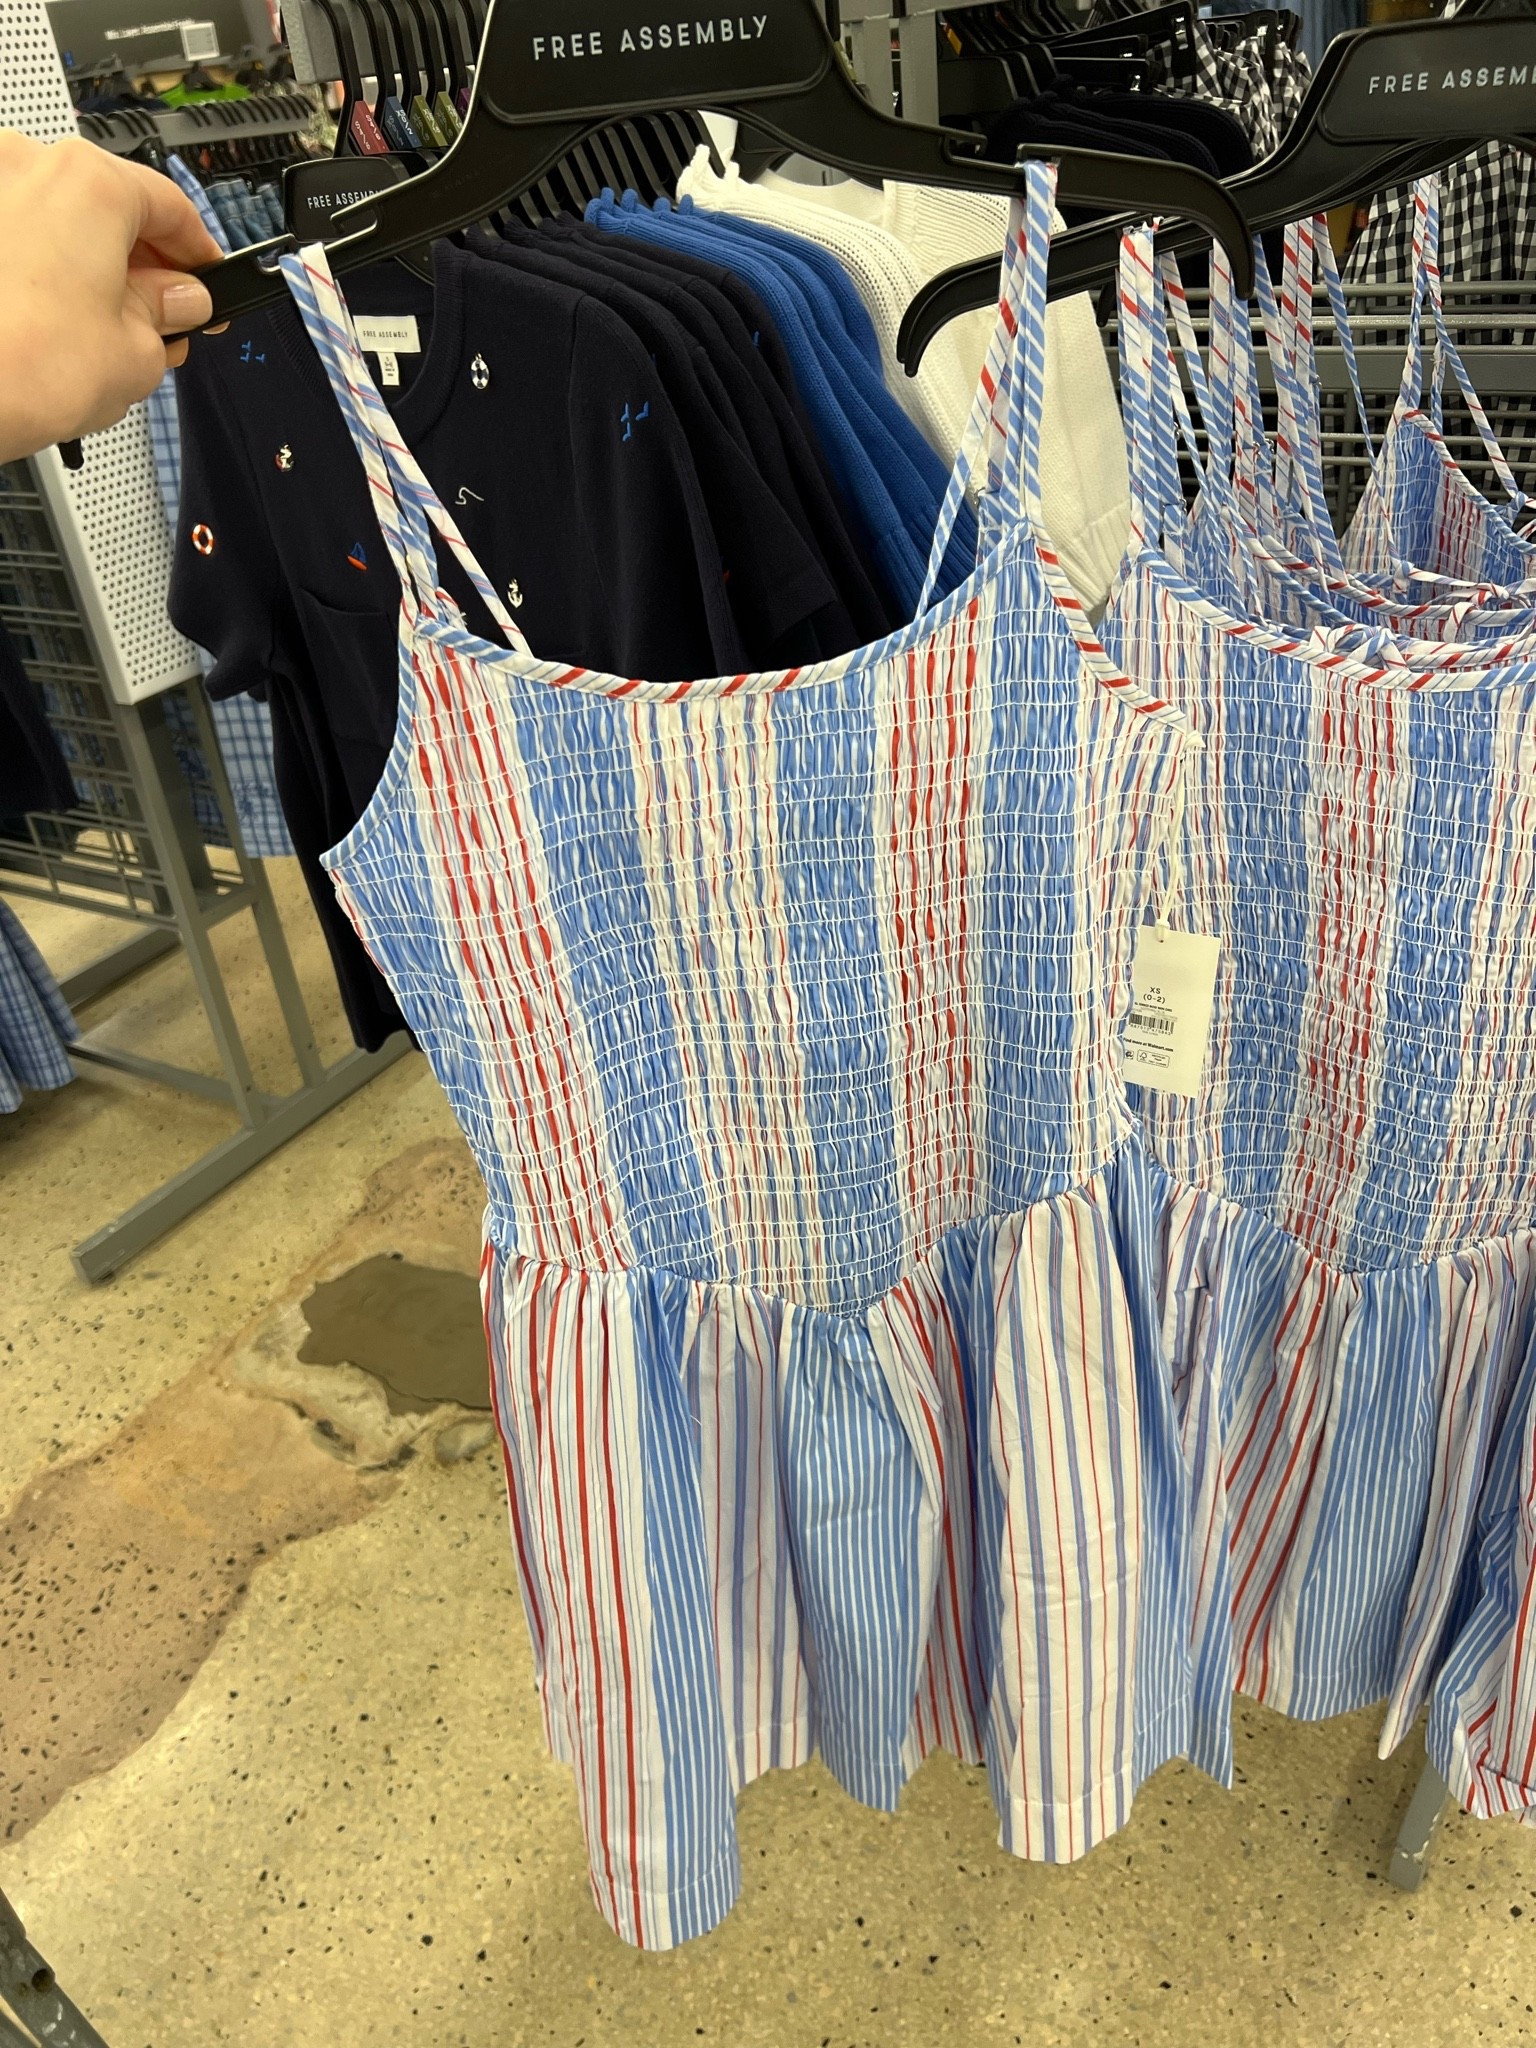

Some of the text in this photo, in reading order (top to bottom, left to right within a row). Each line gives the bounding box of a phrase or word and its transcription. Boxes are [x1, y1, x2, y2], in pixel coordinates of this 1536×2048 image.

[532, 14, 768, 61] FREE ASSEMBLY
[1368, 71, 1429, 95] FREE
[307, 189, 384, 209] FREE ASSEM
[363, 330, 408, 338] FREE ASSEMBLY
[1149, 986, 1161, 994] XS
[1143, 993, 1166, 1005] (0-2)
